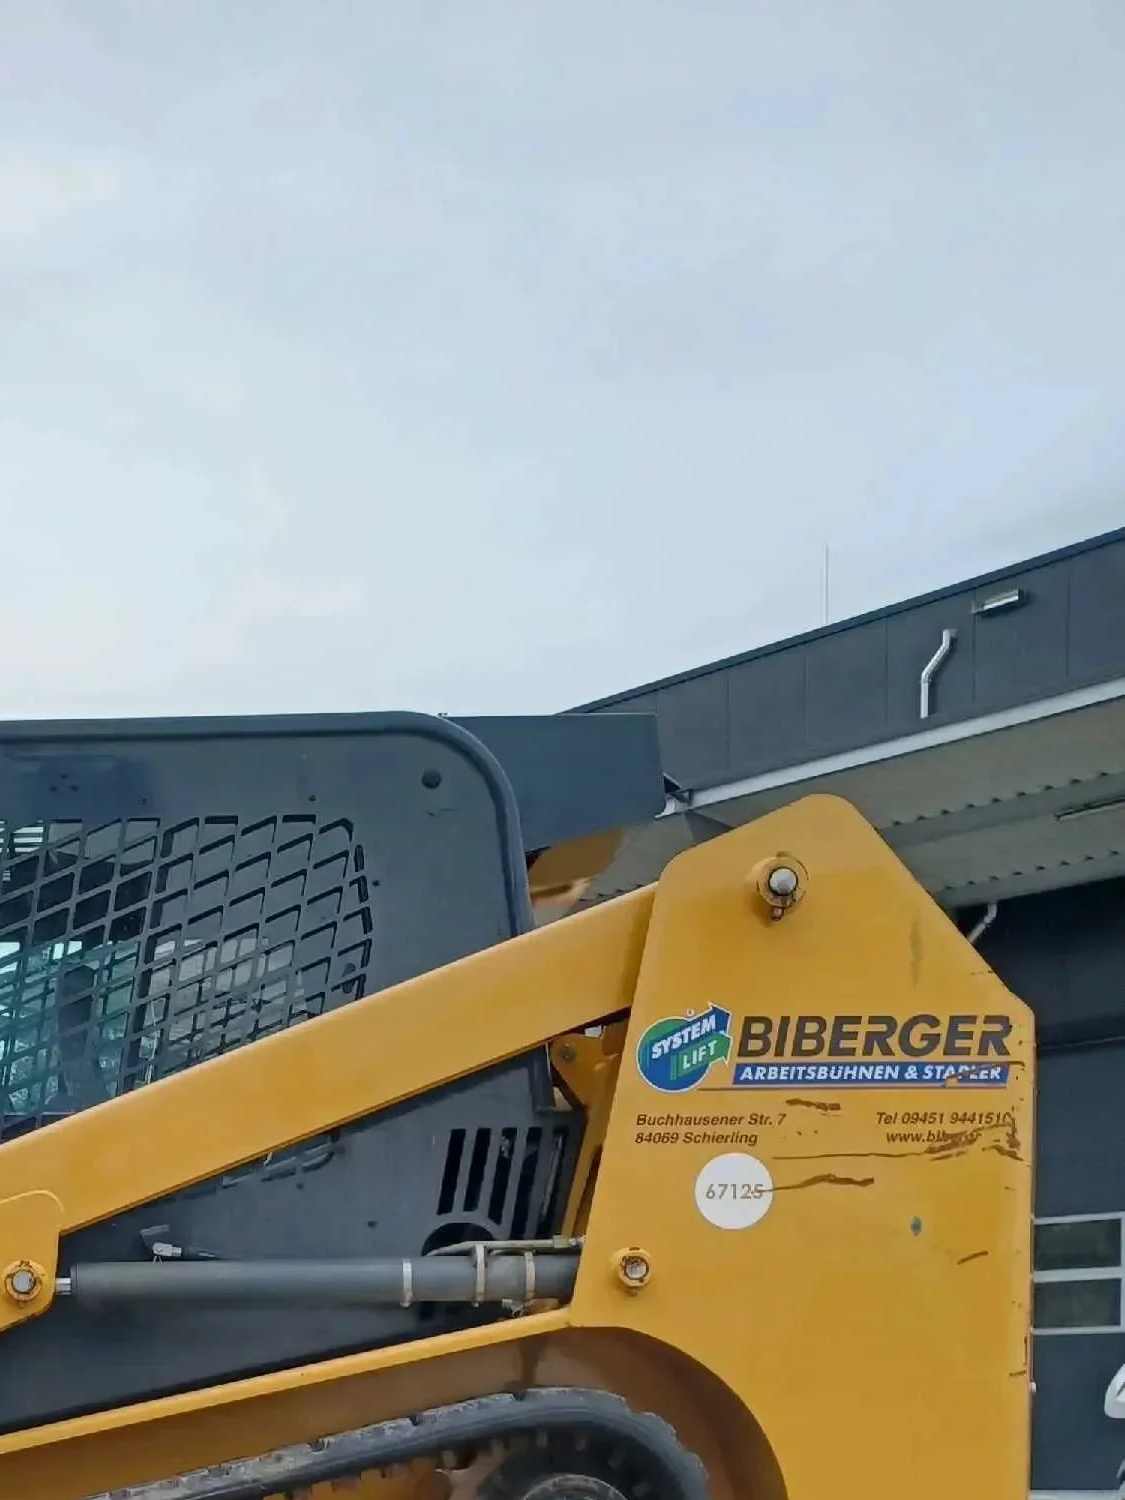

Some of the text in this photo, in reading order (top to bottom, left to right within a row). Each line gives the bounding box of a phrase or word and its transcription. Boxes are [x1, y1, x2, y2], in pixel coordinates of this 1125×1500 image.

[651, 1014, 716, 1060] SYSTEM
[736, 1014, 1013, 1058] BIBERGER
[682, 1040, 717, 1070] LIFT
[740, 1064, 900, 1081] ARBEITSBÜHNEN
[903, 1065, 918, 1080] &
[636, 1113, 787, 1126] Buchhausener Str. 7
[877, 1111, 896, 1125] Tel
[901, 1112, 944, 1125] 09451
[635, 1131, 758, 1147] 84069 Schierling
[705, 1183, 764, 1200] 67125
